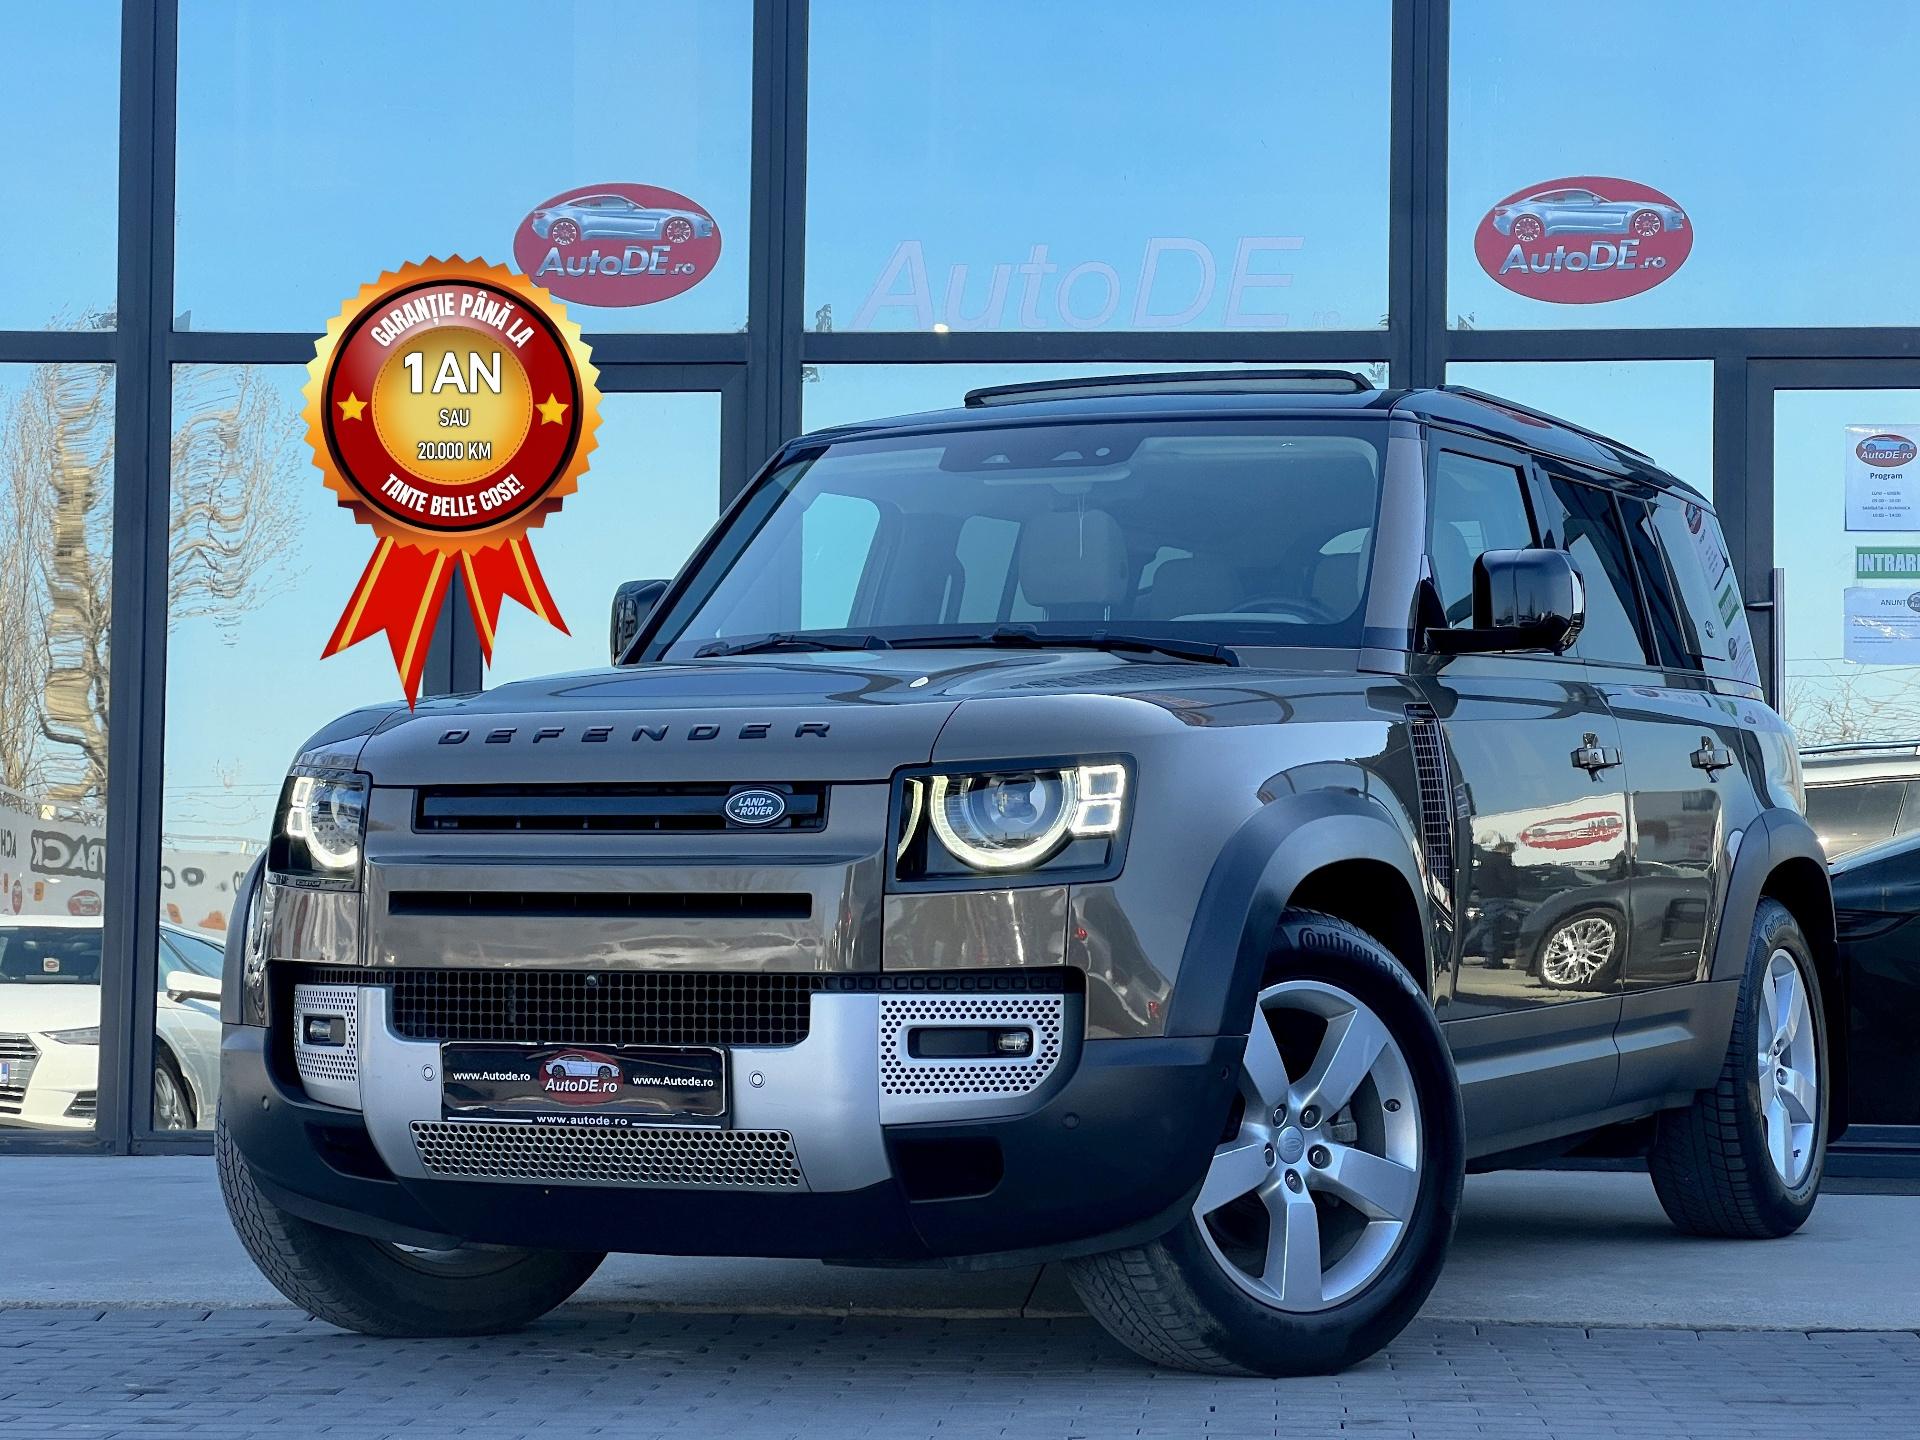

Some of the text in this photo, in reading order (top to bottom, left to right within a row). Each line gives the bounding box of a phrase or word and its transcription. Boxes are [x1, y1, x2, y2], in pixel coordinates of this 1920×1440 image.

[535, 245, 696, 277] AutoDE.ro
[1499, 239, 1667, 275] AutoDE.ro
[1861, 450, 1913, 460] AutoDE.ro
[1869, 472, 1903, 481] Program
[437, 721, 831, 745] DEFENDER
[453, 1071, 531, 1081] www.Autode.ro
[632, 1076, 714, 1087] www.Autode.ro
[545, 1078, 618, 1093] AutoDE.ro
[537, 1115, 628, 1126] www.autode.ro
